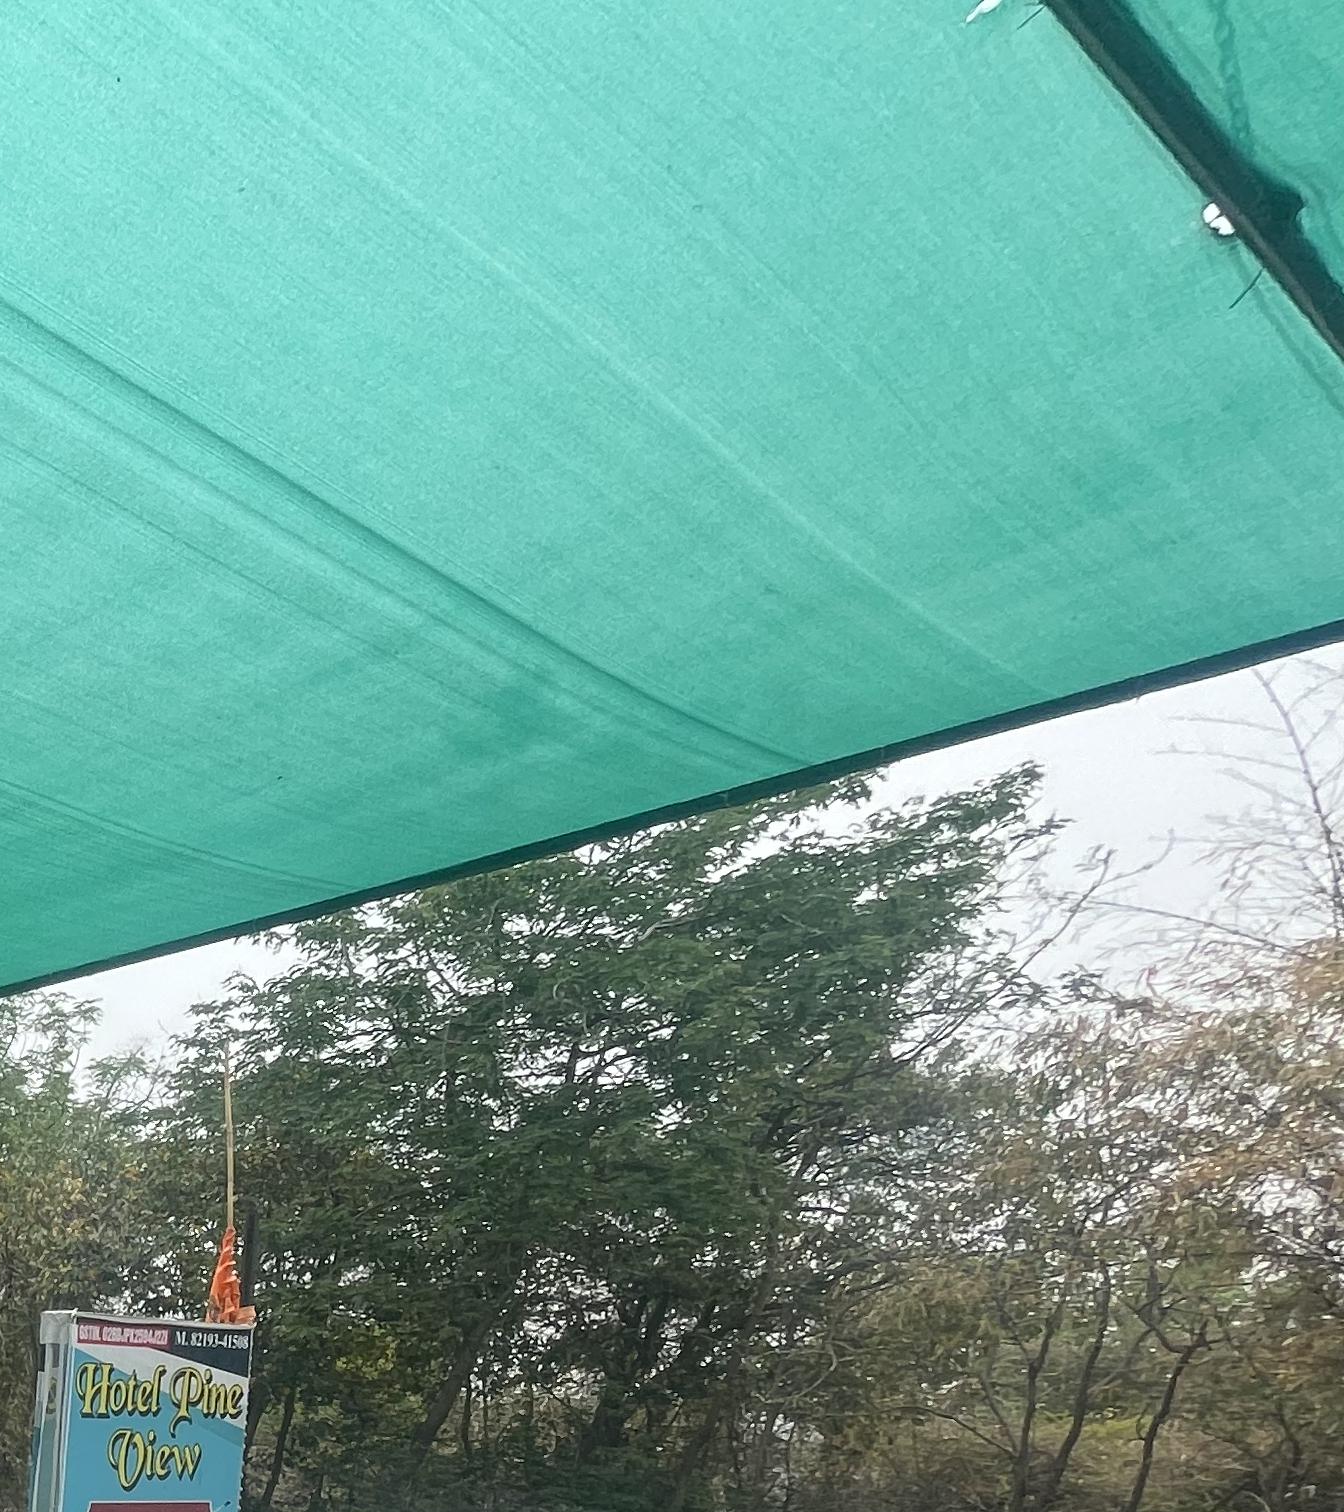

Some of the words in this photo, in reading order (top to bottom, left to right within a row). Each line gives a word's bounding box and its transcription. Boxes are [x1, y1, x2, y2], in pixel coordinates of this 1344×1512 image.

[76, 1362, 166, 1418] Hotel
[169, 1366, 244, 1438] Pine
[107, 1428, 201, 1491] View
